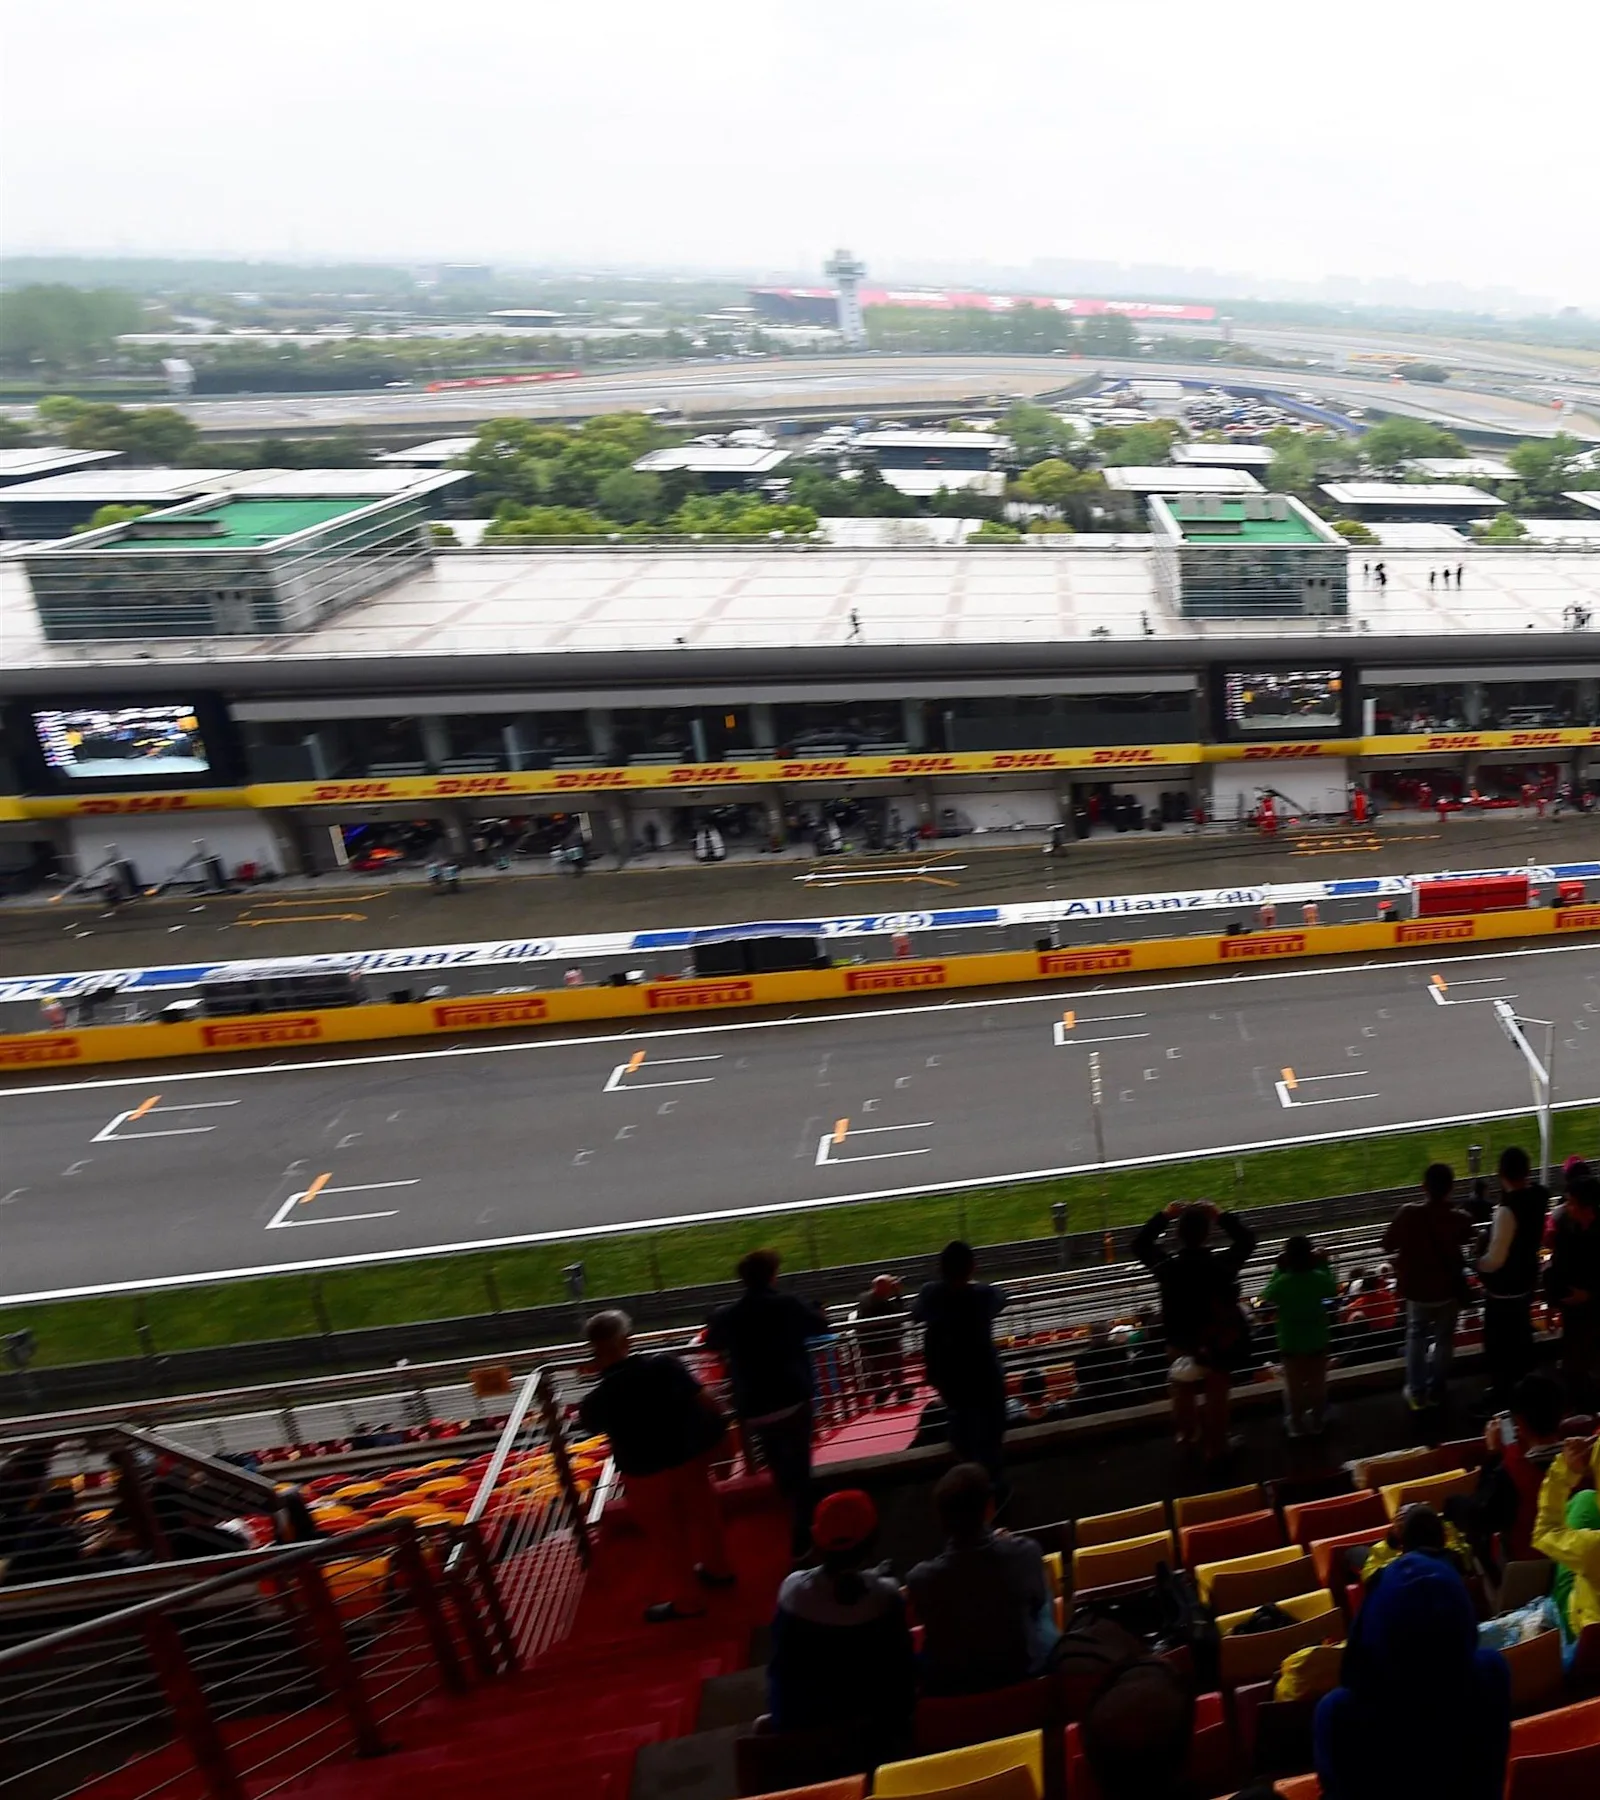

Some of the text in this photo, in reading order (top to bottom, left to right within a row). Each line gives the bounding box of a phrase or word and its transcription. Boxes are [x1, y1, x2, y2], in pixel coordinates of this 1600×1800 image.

[1427, 736, 1481, 750] DHL
[1510, 732, 1561, 746] DHL
[1092, 750, 1154, 764] DHL
[1244, 745, 1324, 760] DHL
[889, 758, 956, 773] DHL
[992, 753, 1057, 769] DHL
[669, 767, 742, 783] DHL
[781, 762, 852, 778] DHL
[436, 778, 513, 795] DHL
[556, 772, 630, 788] DHL
[316, 783, 393, 800] DHL
[1064, 895, 1201, 917] Allianz
[1395, 919, 1475, 943] PIRELLI
[1219, 934, 1306, 959] PIRELLI
[1038, 948, 1132, 975] PIRELLI
[845, 964, 947, 992] PIRELLI
[645, 981, 753, 1010] PIRELLI
[433, 998, 548, 1028] PIRELLI
